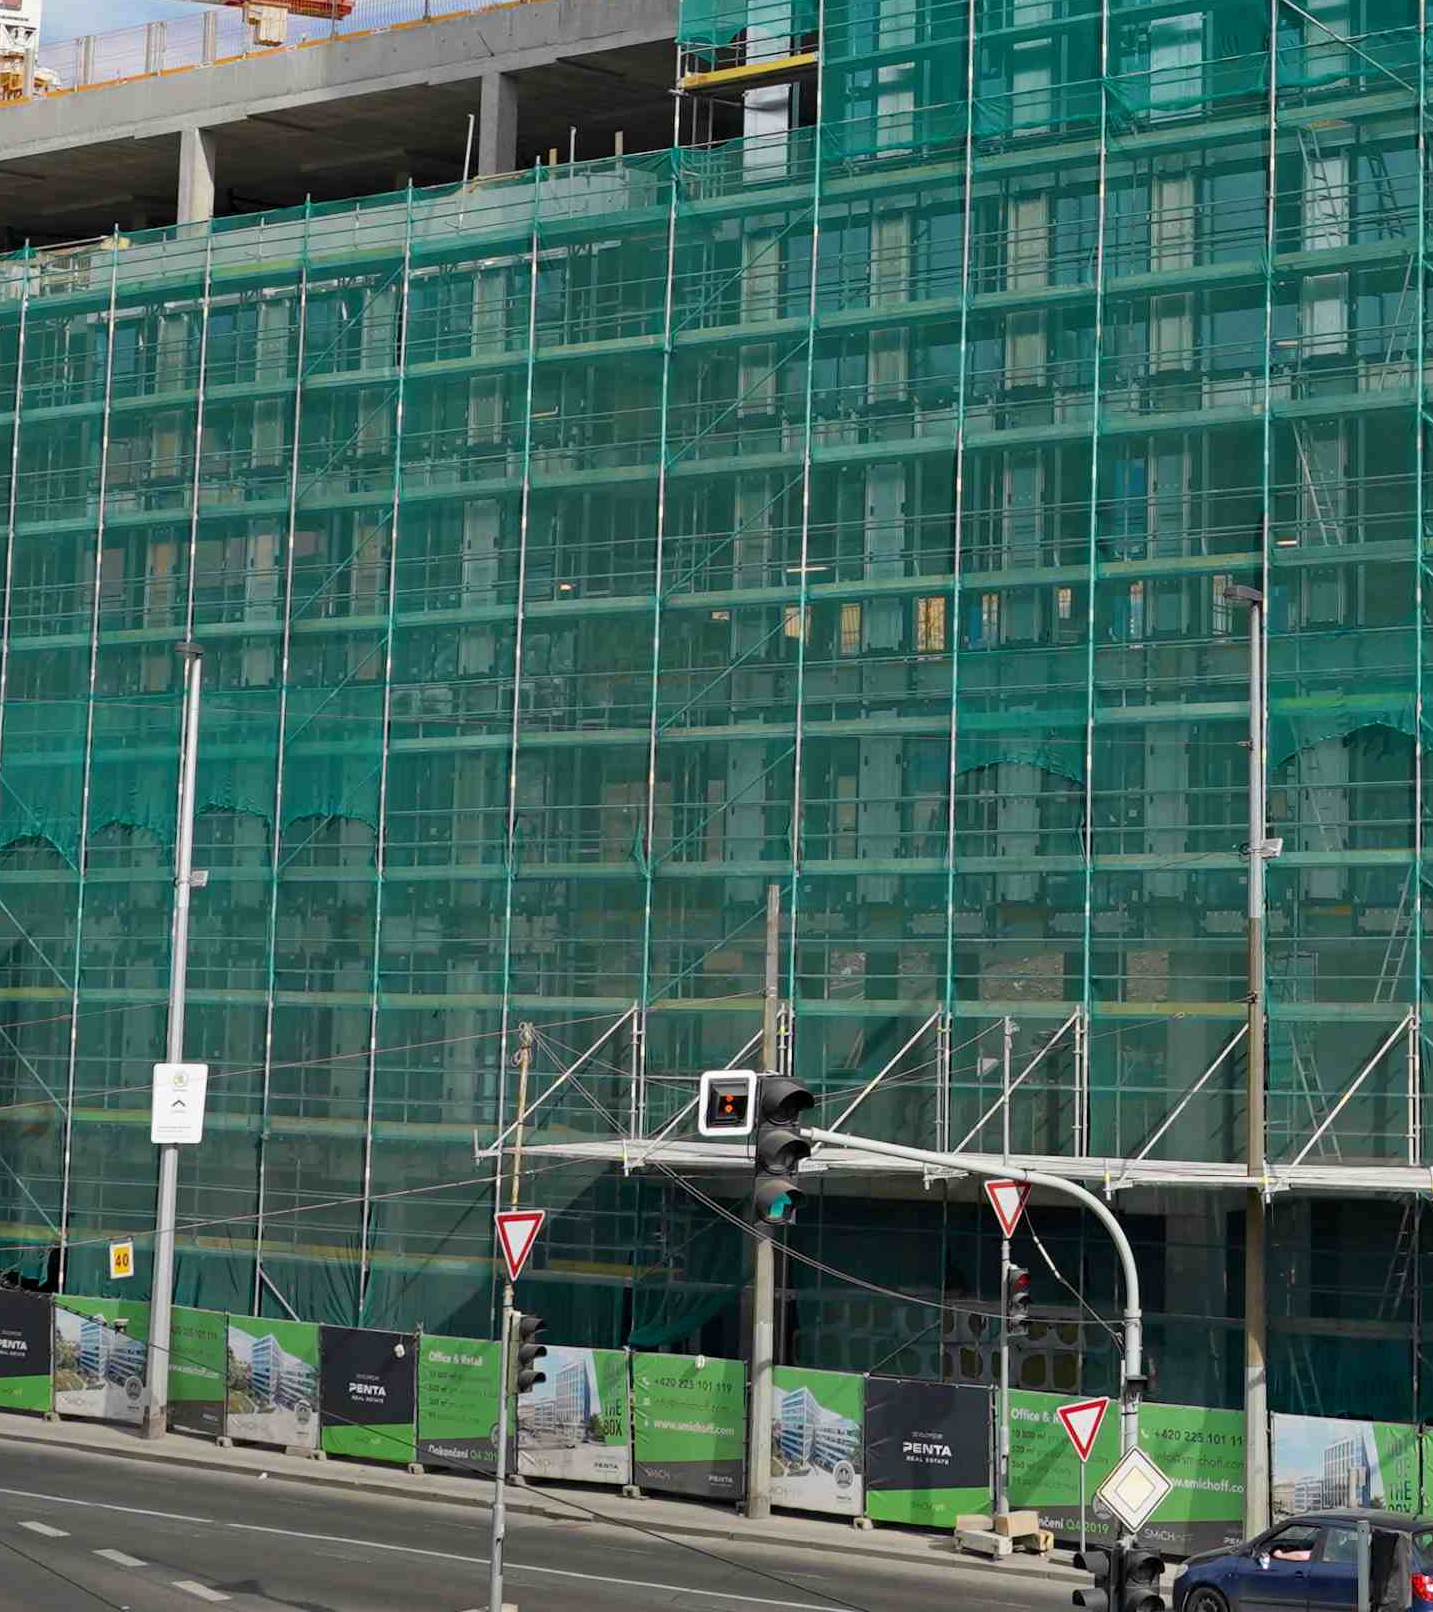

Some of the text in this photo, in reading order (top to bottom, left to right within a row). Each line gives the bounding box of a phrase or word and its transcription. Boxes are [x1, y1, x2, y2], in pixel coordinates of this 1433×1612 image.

[114, 1252, 129, 1268] 40
[348, 1381, 387, 1397] PENTA
[1010, 1407, 1040, 1422] Office
[1154, 1429, 1180, 1441] +420
[1184, 1431, 1204, 1444] 225
[1207, 1433, 1226, 1445] 101
[902, 1441, 953, 1457] PENTA
[1389, 1480, 1412, 1501] THE
